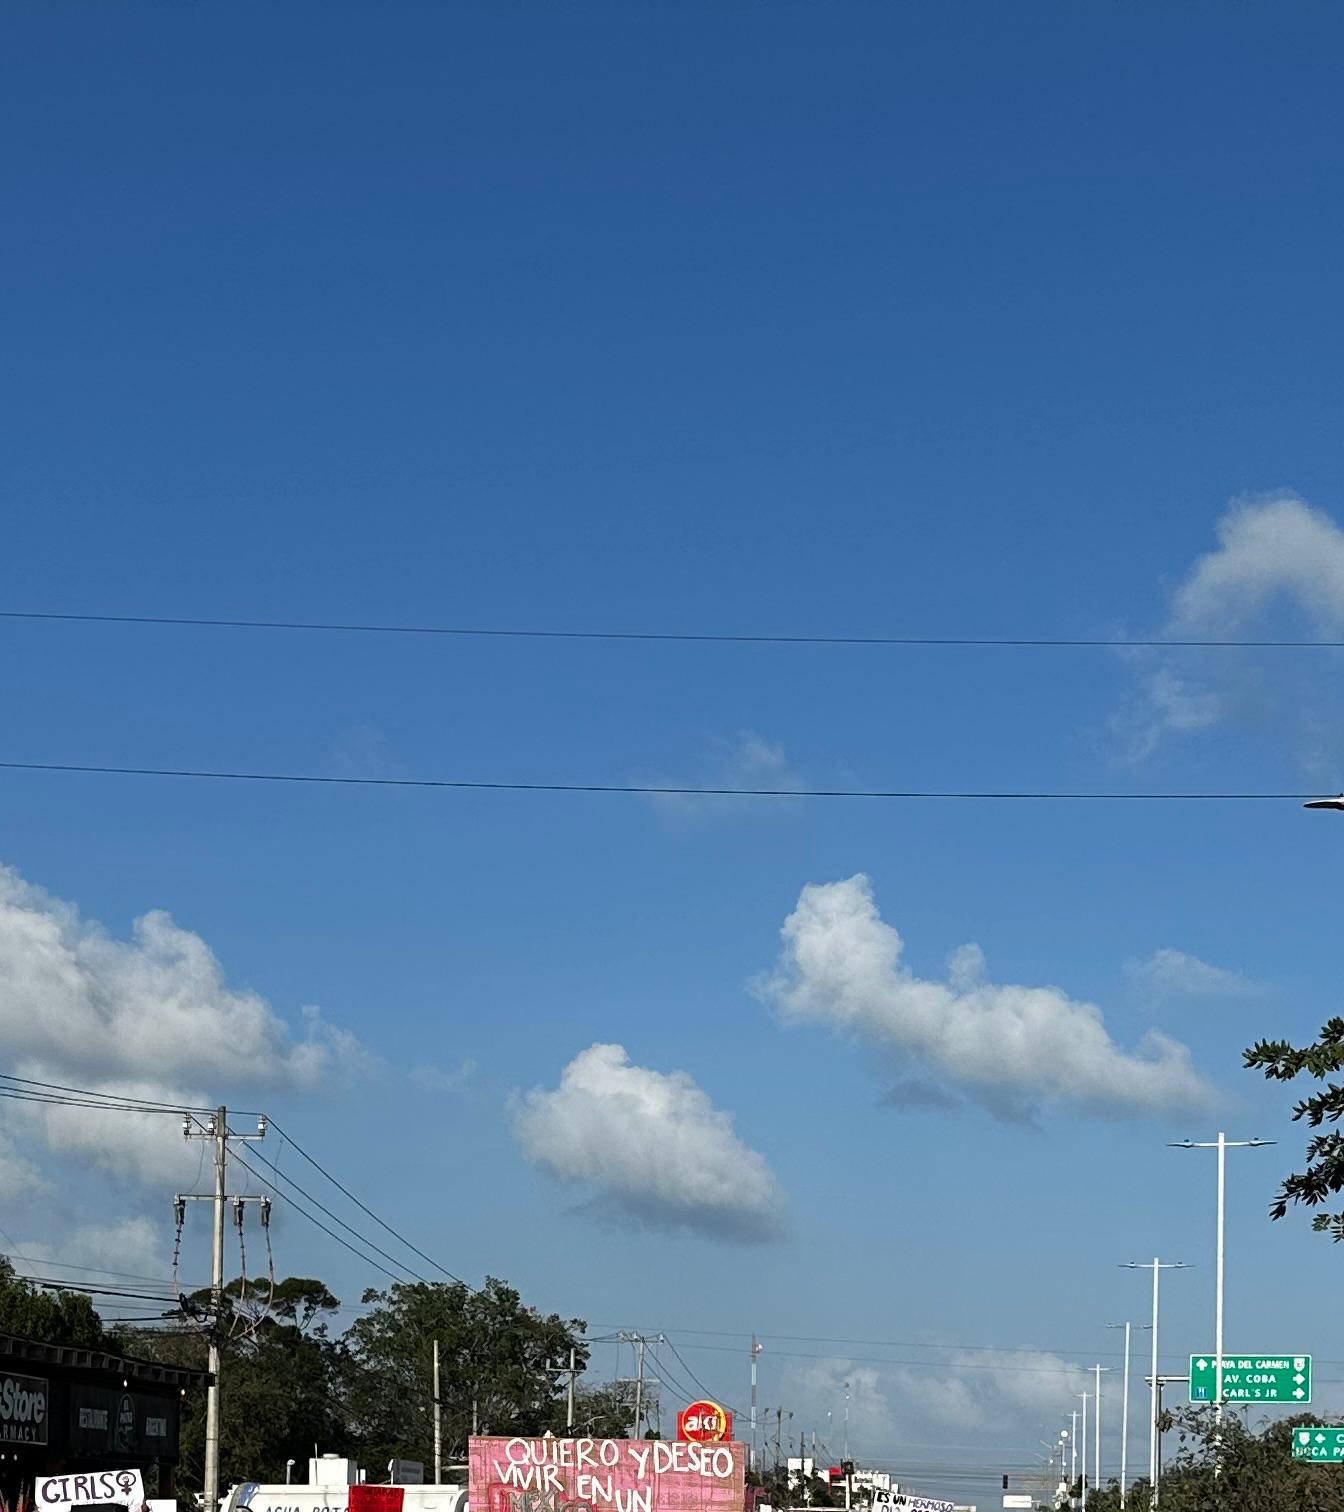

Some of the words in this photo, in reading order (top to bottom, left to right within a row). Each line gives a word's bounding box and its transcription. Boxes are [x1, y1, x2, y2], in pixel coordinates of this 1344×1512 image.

[1212, 1360, 1236, 1370] PAYA
[1238, 1360, 1253, 1370] DEL
[1255, 1360, 1290, 1370] CARMEN
[1224, 1374, 1242, 1384] AV.
[1245, 1374, 1277, 1384] COBA
[1265, 1388, 1278, 1398] JR
[505, 1437, 620, 1471] QUIERO
[629, 1446, 651, 1480] Y
[653, 1440, 734, 1479] DESEO
[41, 1472, 116, 1504] GIRLS
[494, 1459, 565, 1493] VIVIR
[576, 1474, 613, 1505] EN
[892, 1494, 907, 1506] UN
